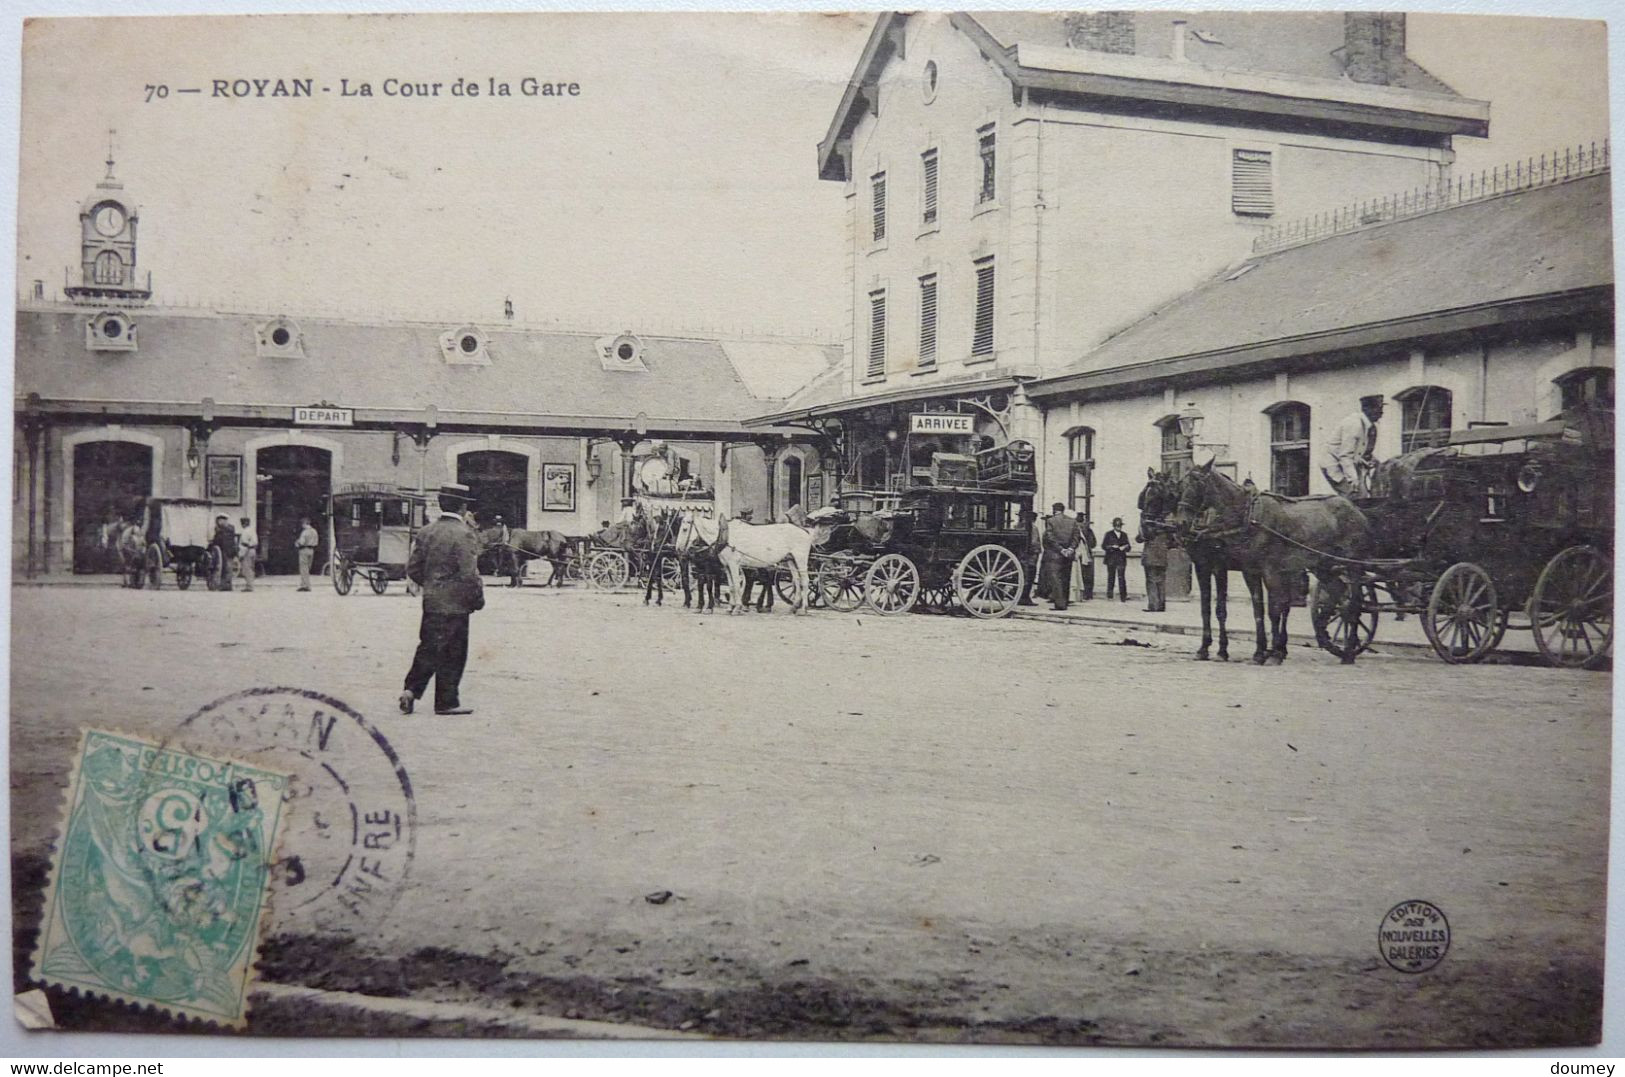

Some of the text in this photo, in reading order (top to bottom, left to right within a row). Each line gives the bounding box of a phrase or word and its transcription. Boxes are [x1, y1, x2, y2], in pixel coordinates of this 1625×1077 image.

[144, 84, 170, 103] 70
[211, 79, 314, 98] ROYAN
[340, 79, 374, 97] La
[383, 78, 443, 97] Cour
[450, 78, 480, 97] de
[487, 77, 512, 97] la
[520, 77, 582, 97] Gare
[299, 410, 348, 421] DEPART
[916, 418, 969, 430] ARRIVEE
[143, 750, 230, 785] POSTES
[1390, 903, 1440, 923] EDITION
[1382, 930, 1446, 942] NOUVELLES
[1389, 946, 1440, 960] GALERIES
